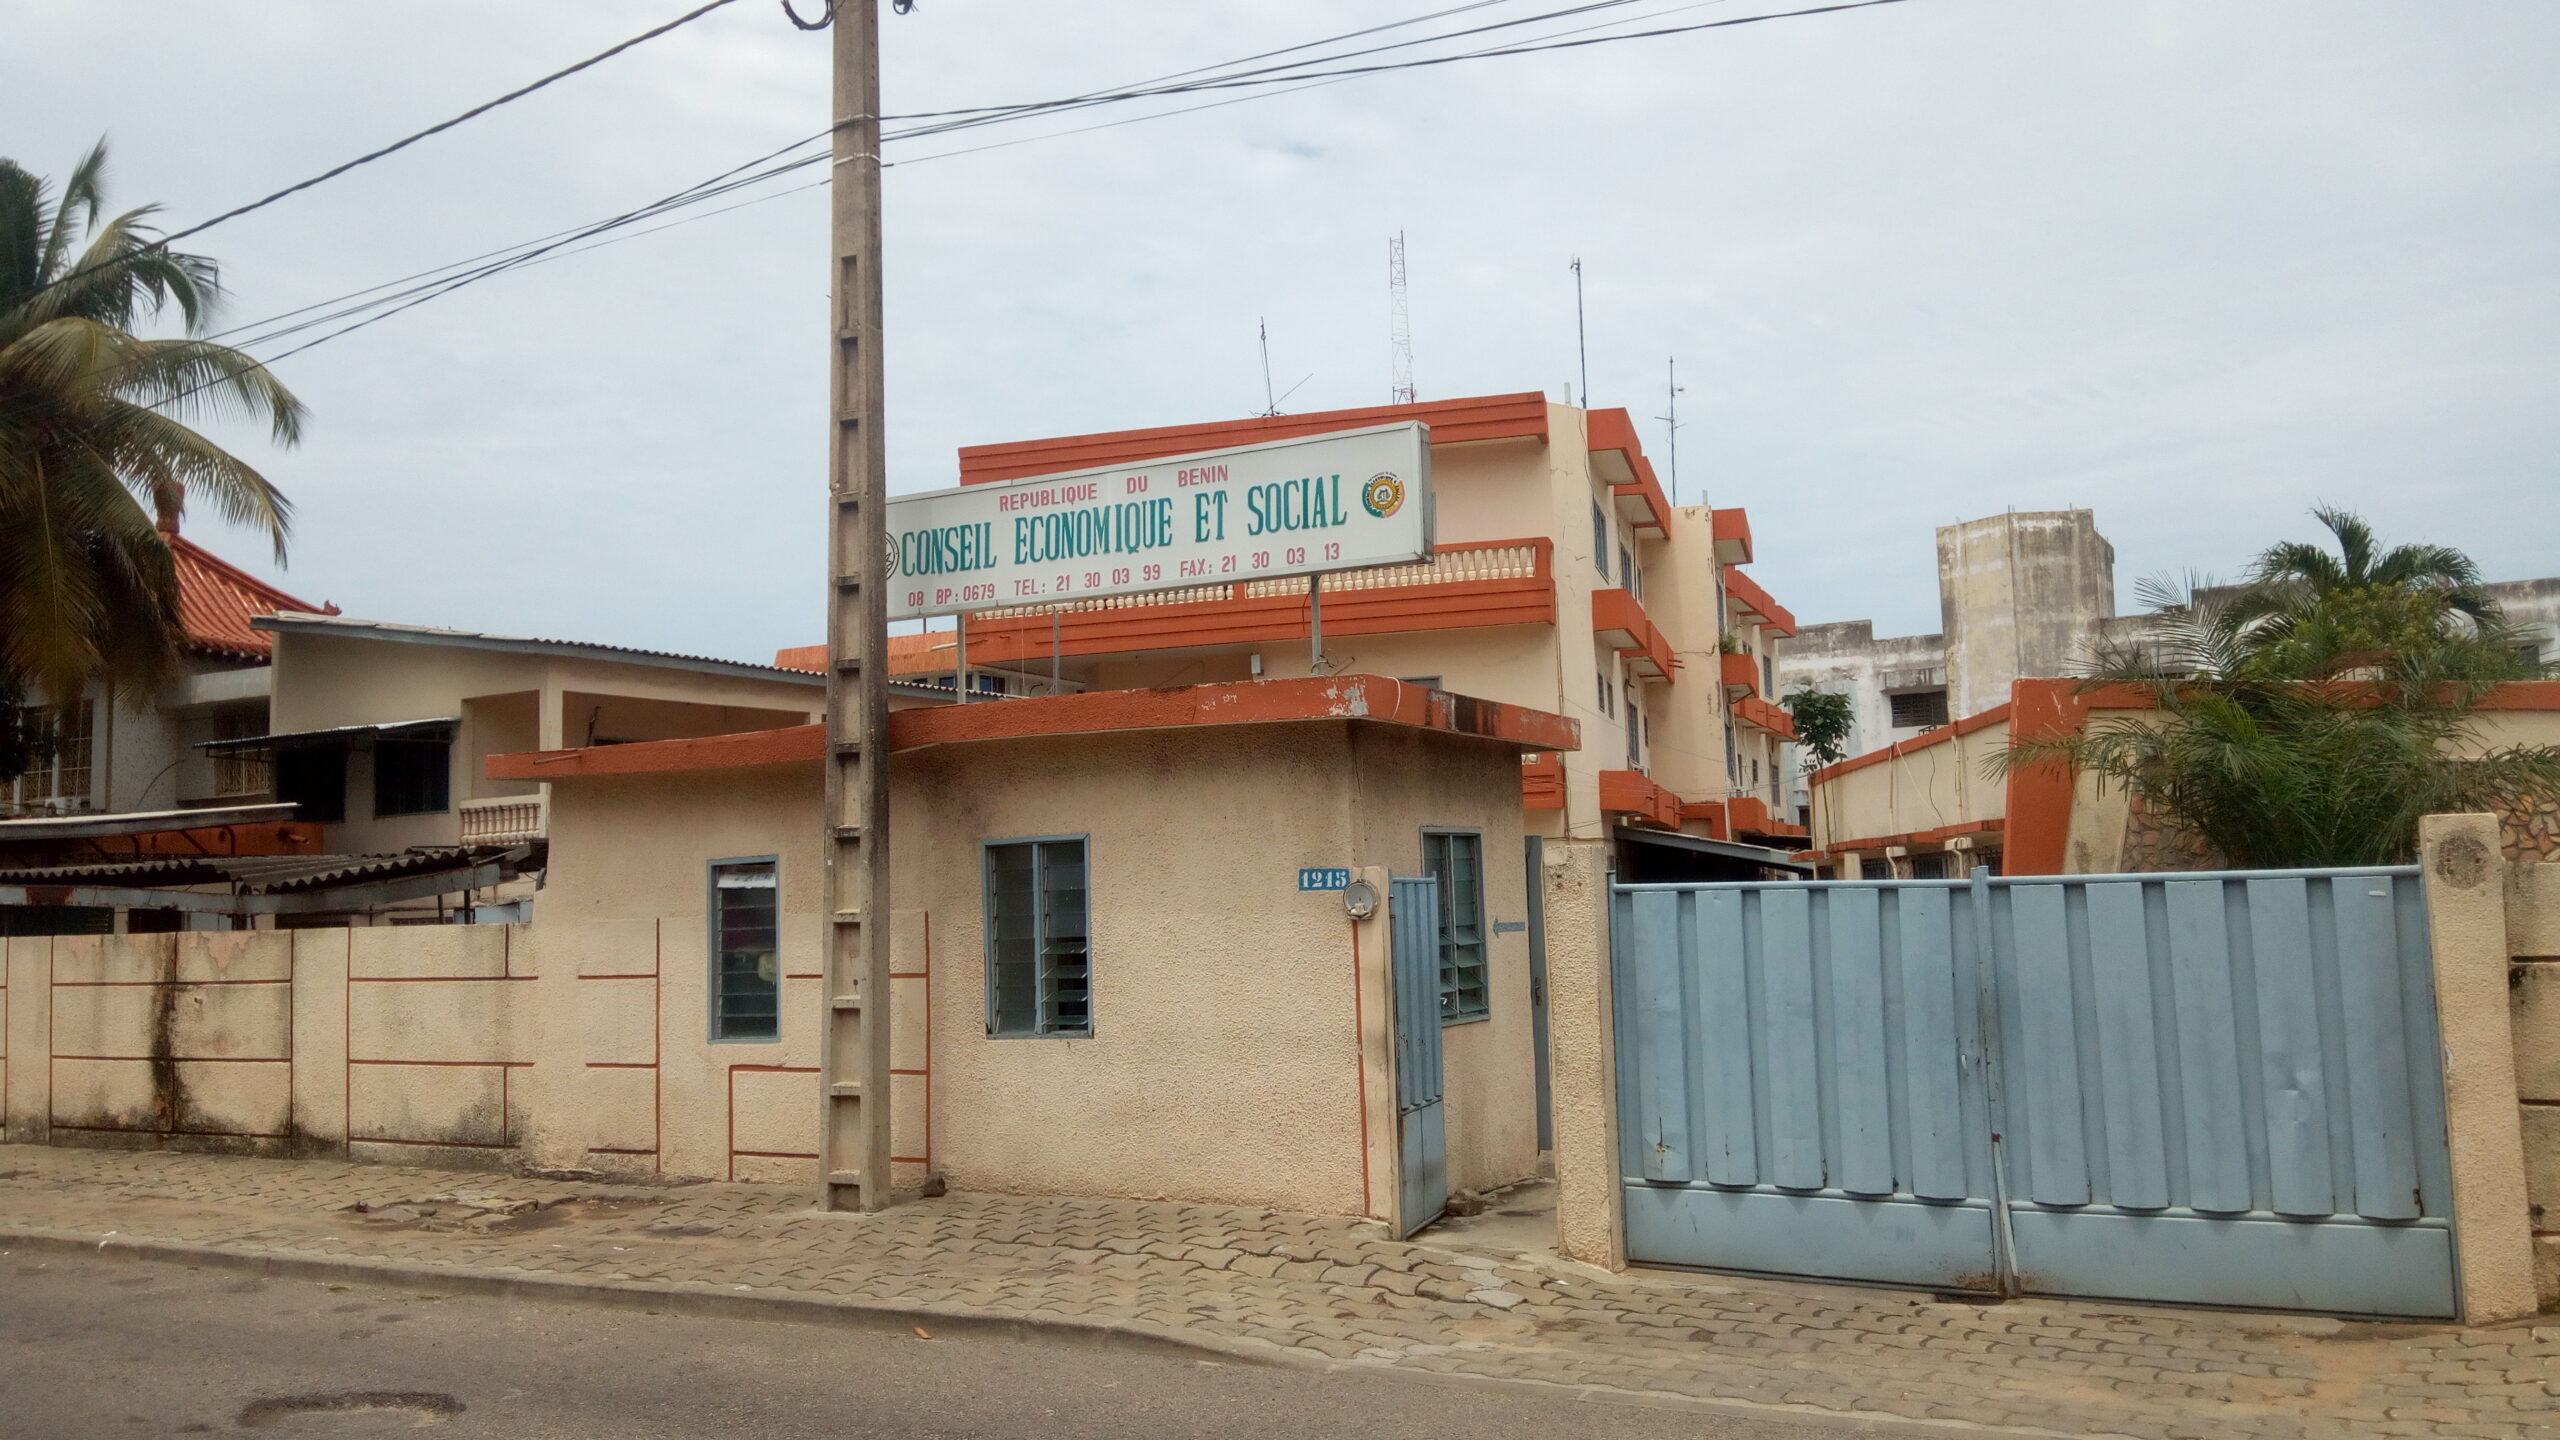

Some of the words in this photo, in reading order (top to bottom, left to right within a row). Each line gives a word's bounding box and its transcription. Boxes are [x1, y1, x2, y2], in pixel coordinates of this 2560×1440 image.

[999, 483, 1098, 512] REPUBLIQUE
[1126, 475, 1148, 494] DU
[1177, 464, 1228, 487] BENIN
[902, 522, 997, 577] CONSEIL
[1014, 497, 1173, 565] ECONOMIQUE
[1194, 490, 1228, 543] ET
[1247, 474, 1347, 536] SOCIAL
[908, 591, 924, 607] 08
[1056, 575, 1071, 592] 21
[1084, 572, 1101, 588] 30
[1112, 568, 1130, 585] 03
[1143, 564, 1161, 581] 99
[1221, 555, 1237, 573] 21
[1252, 551, 1270, 569] 30
[1286, 547, 1305, 565] 03
[1324, 542, 1340, 561] 13
[1302, 871, 1347, 888] 1215
